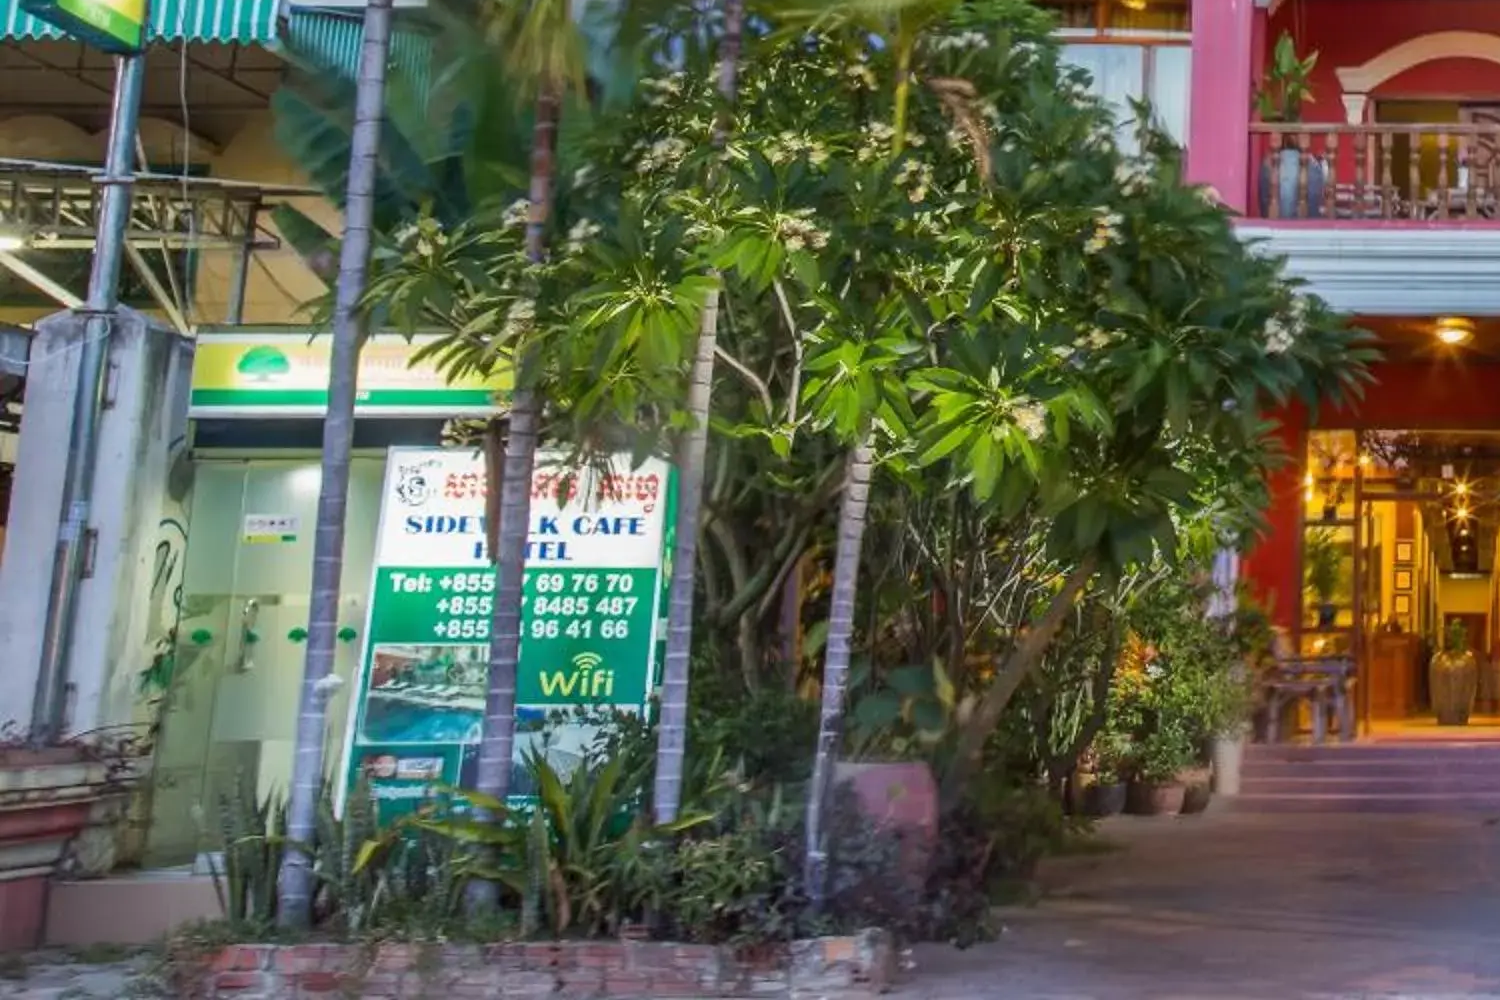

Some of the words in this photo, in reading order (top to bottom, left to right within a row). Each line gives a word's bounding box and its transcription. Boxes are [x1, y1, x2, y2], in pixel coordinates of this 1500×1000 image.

[405, 516, 560, 536] SIDEK
[572, 515, 646, 535] CAFE
[474, 541, 573, 560] HTEL
[389, 573, 431, 592] Tel:
[439, 573, 496, 592] +855
[535, 574, 565, 592] 69
[571, 574, 598, 592] 76
[605, 573, 634, 592] 70
[435, 596, 493, 615] +855
[533, 597, 589, 615] 8485
[595, 597, 639, 615] 487
[433, 620, 490, 638] +855
[531, 620, 560, 638] 96
[565, 620, 593, 638] 41
[600, 620, 629, 638] 66
